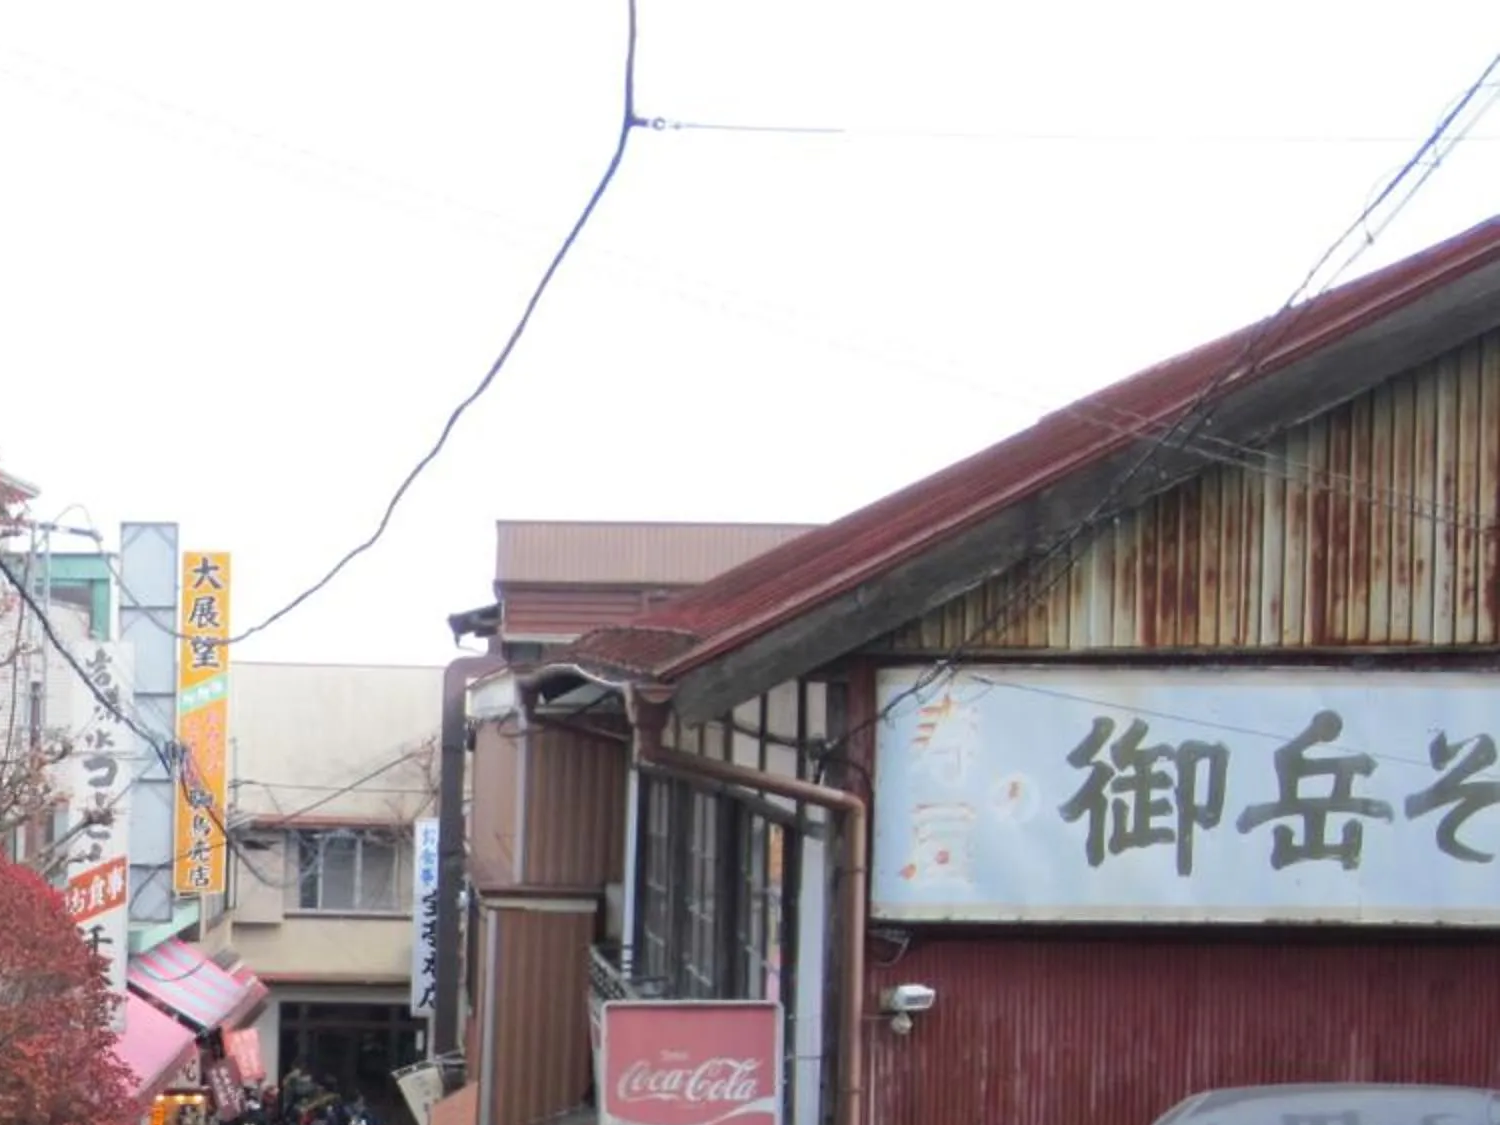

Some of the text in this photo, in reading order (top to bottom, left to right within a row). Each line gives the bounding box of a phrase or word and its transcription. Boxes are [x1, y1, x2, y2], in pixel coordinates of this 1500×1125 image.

[188, 556, 224, 670] 大展望
[64, 863, 126, 916] お食事
[617, 1056, 763, 1102] Coca-Cola
